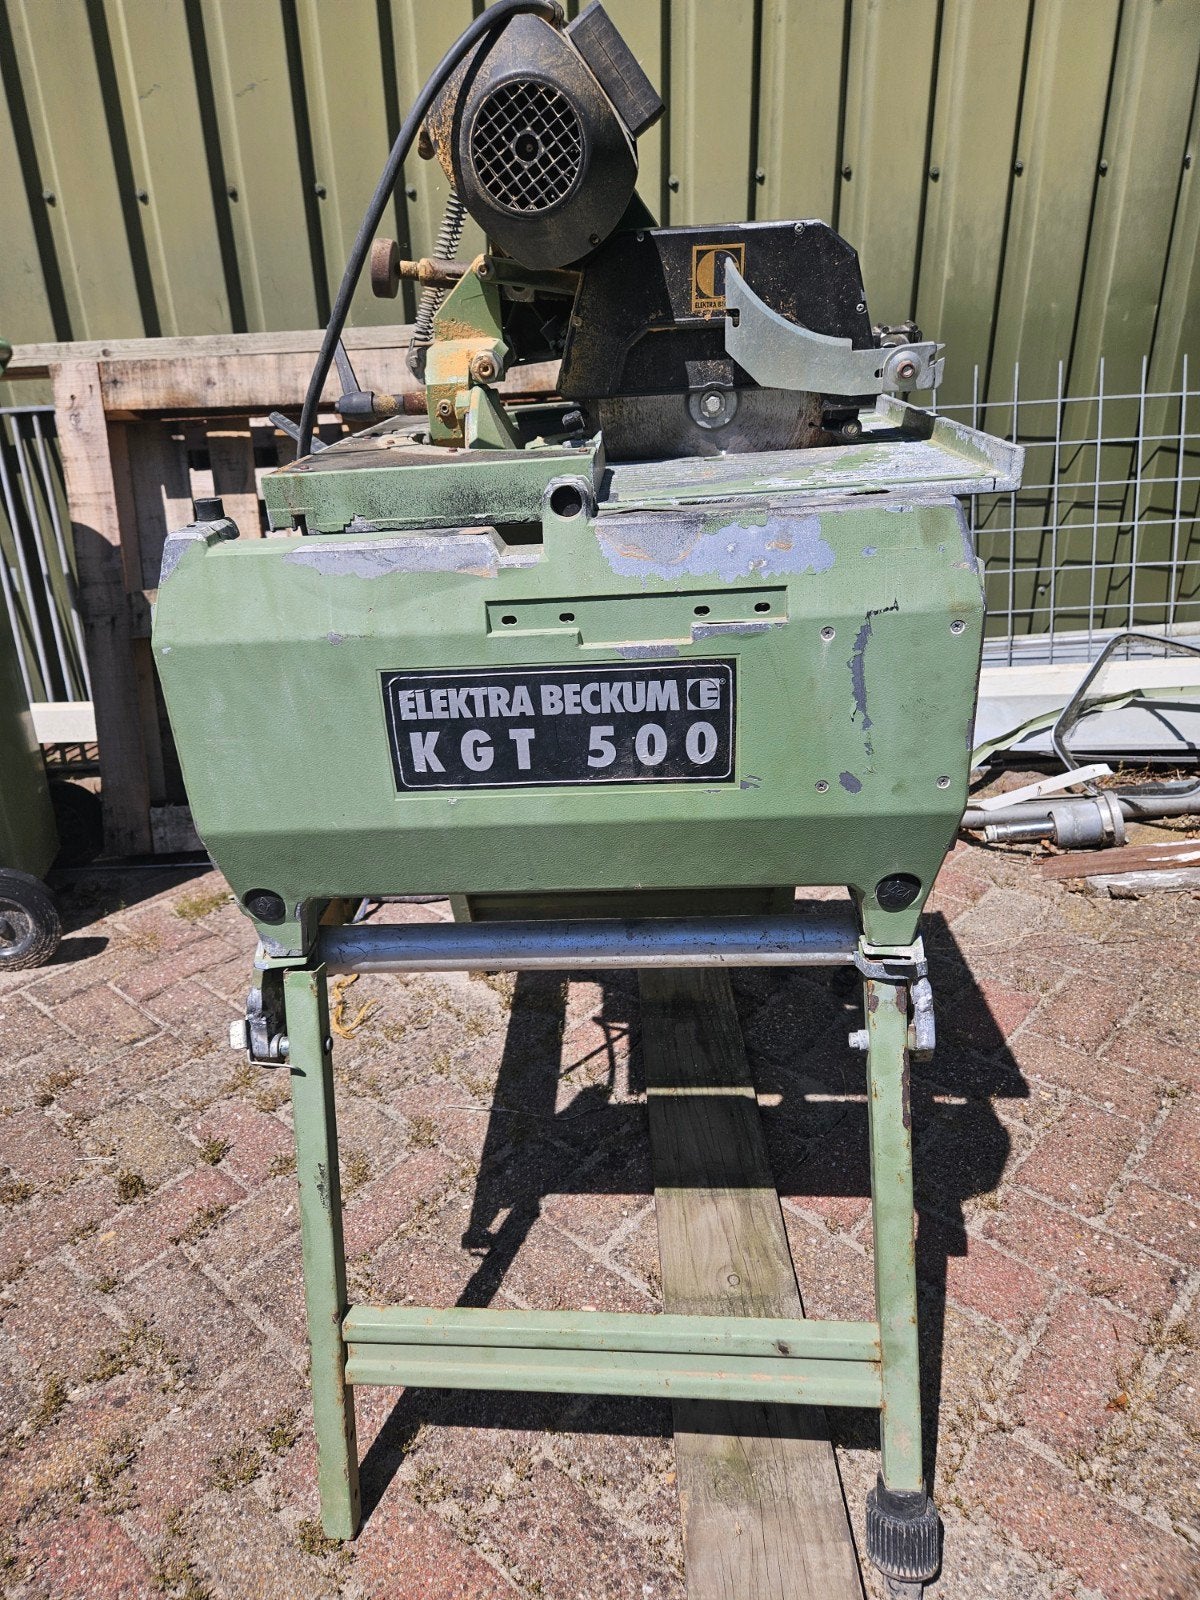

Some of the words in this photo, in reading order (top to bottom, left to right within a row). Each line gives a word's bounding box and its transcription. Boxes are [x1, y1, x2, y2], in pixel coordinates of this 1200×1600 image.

[694, 301, 717, 309] ELEKTRA
[398, 685, 535, 720] ELEKTRA
[541, 681, 679, 716] BECKUM
